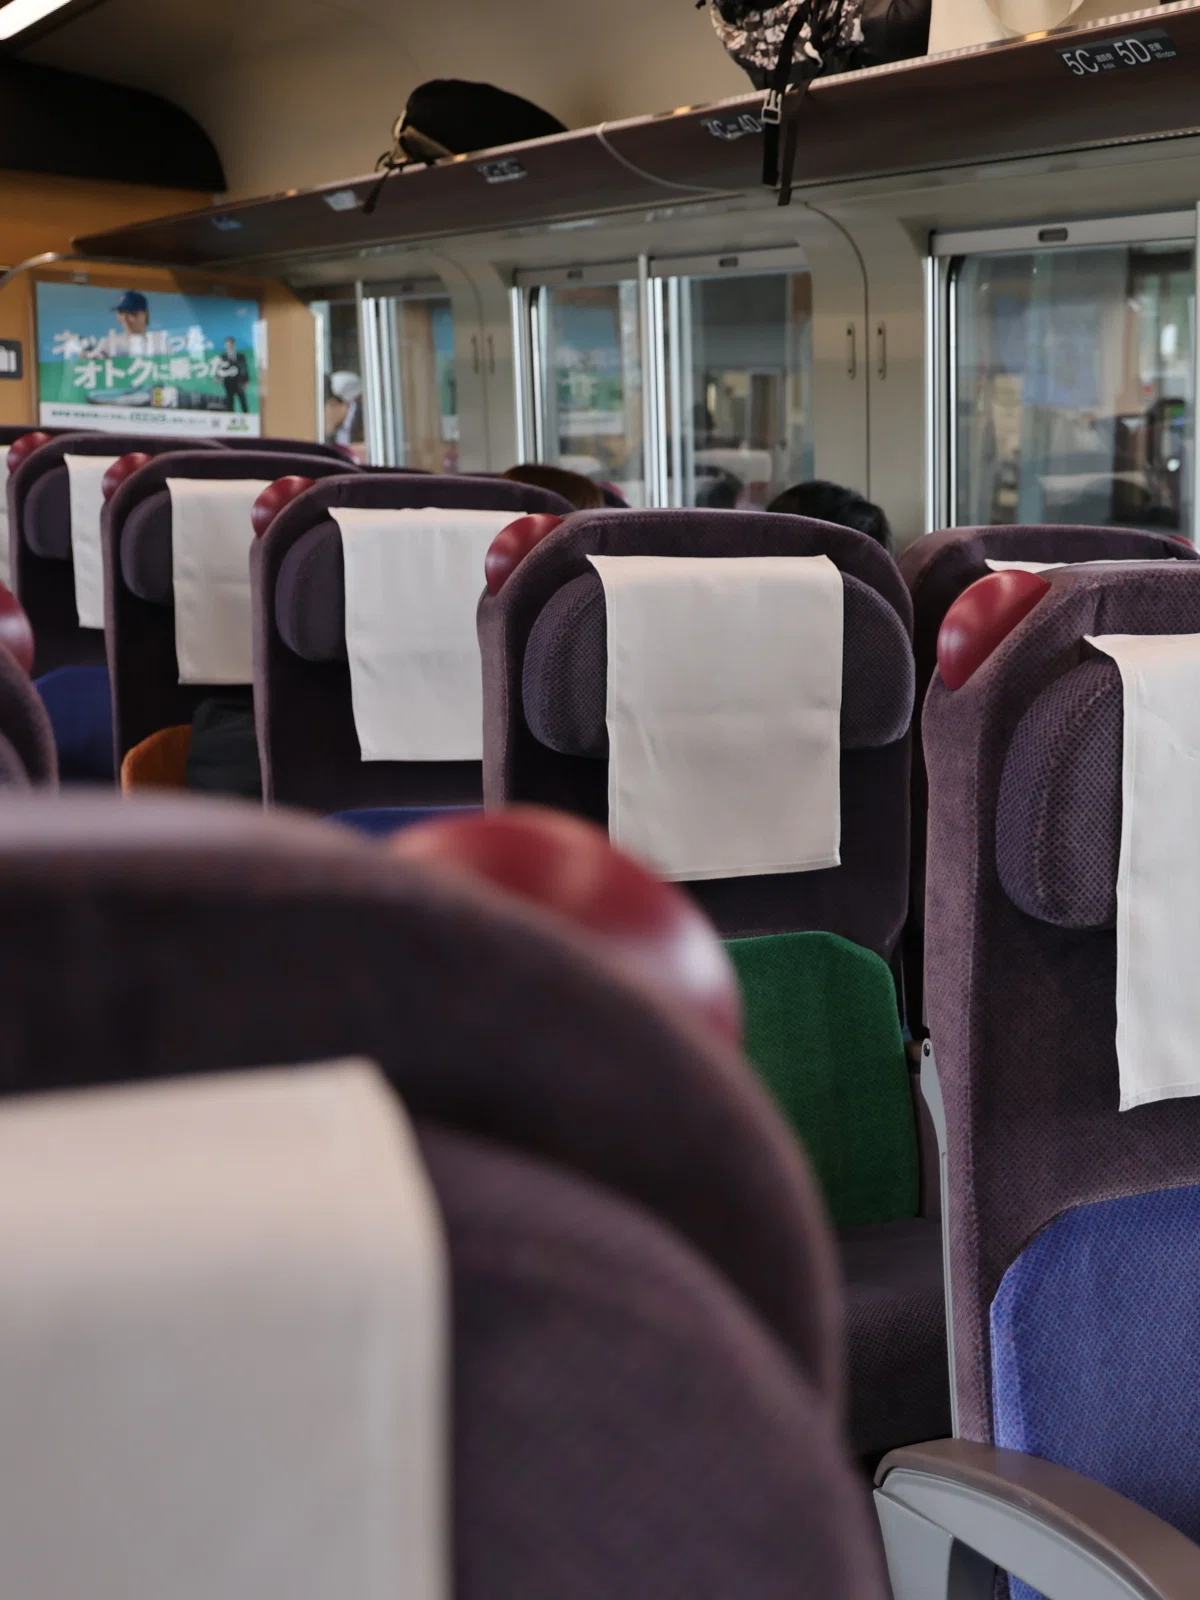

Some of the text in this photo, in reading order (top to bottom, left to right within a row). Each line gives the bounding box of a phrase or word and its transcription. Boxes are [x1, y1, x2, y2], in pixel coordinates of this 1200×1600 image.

[1062, 49, 1099, 75] 5C
[1113, 39, 1151, 65] 5D
[738, 114, 762, 133] 4D
